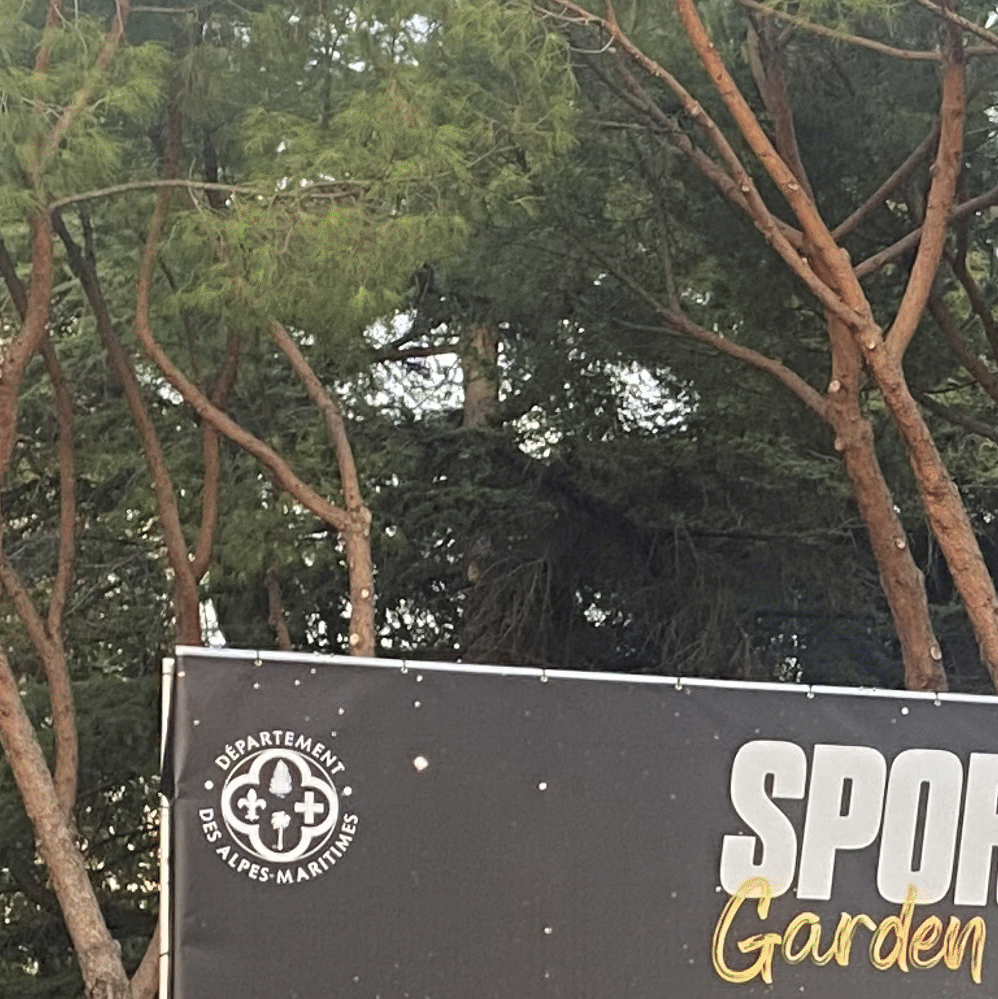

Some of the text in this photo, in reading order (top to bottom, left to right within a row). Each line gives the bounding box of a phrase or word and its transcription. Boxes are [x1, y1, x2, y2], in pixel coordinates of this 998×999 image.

[214, 729, 346, 775] DÉPARTEMENT
[198, 807, 222, 843] DES
[711, 876, 987, 985] Garden
